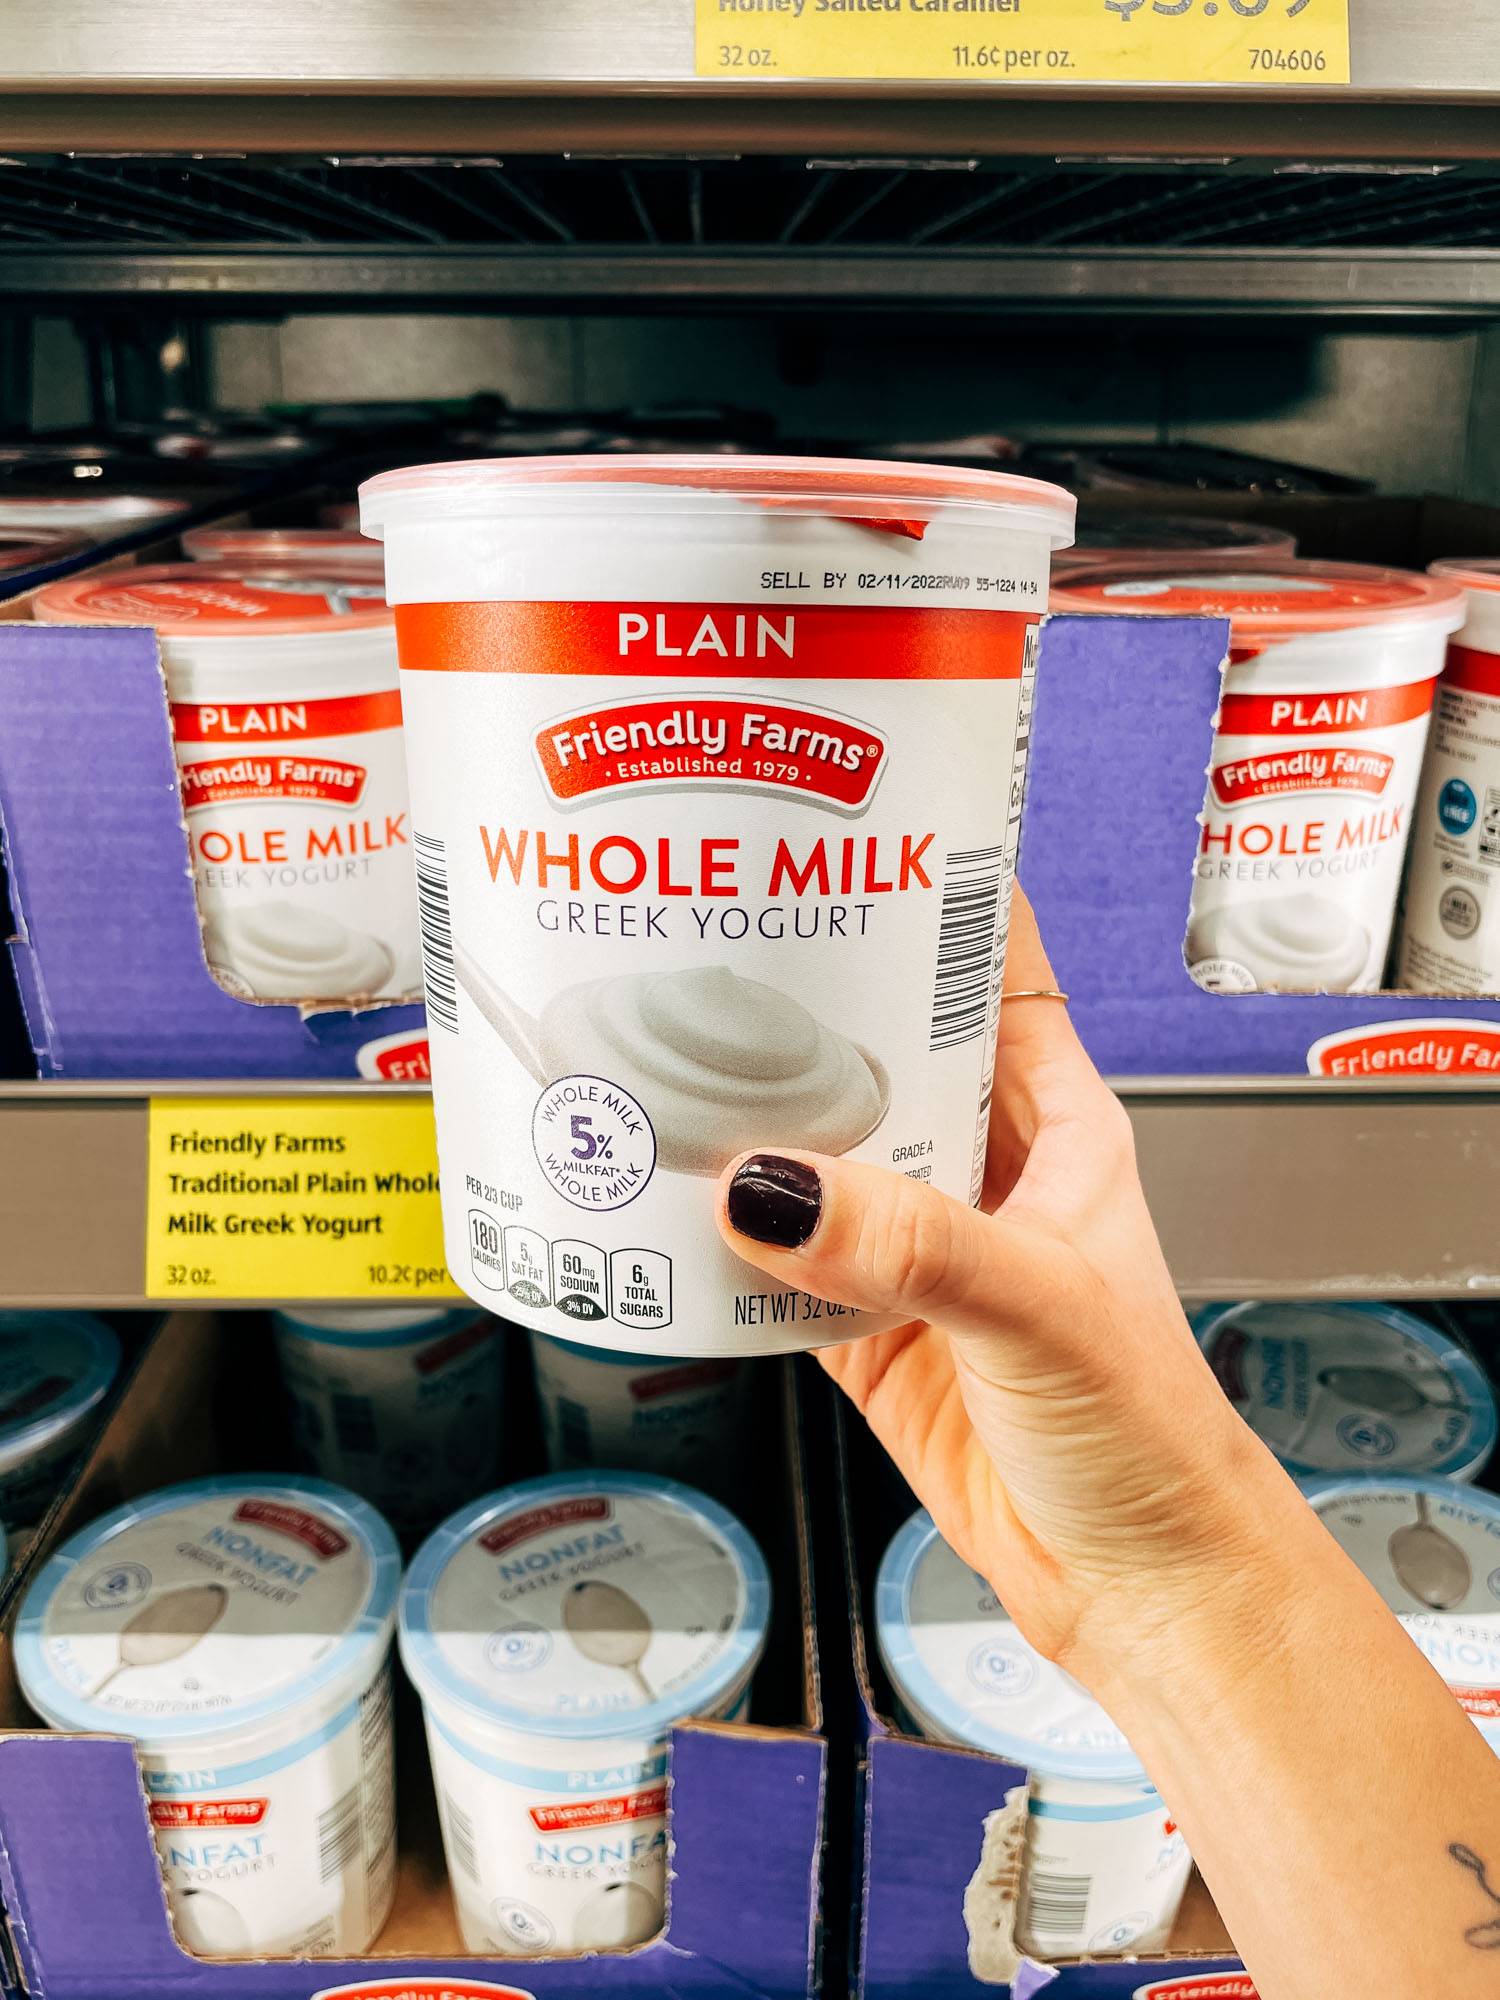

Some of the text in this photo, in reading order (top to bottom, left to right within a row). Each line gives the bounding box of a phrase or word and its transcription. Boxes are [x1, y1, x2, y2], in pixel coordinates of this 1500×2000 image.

[719, 46, 778, 66] 32 oz.
[953, 45, 1076, 71] 11.6¢ per oz.
[1248, 48, 1327, 70] 704606
[760, 571, 811, 590] SELL
[823, 571, 848, 590] BY
[618, 612, 795, 658] PLAIN
[199, 704, 307, 734] PLAIN
[1270, 696, 1369, 728] PLAIN
[550, 709, 727, 770] Friendly
[182, 759, 272, 788] riendly
[616, 756, 800, 781] Established 1979
[1221, 752, 1328, 789] Friendly
[198, 812, 409, 865] OLE MILK
[1200, 821, 1325, 856] HOLE
[1336, 802, 1404, 852] MILK
[203, 857, 373, 889] EEK YOGURT
[479, 824, 936, 897] WHOLE MILK
[1199, 859, 1284, 881] GREEK
[536, 899, 876, 940] GREEK YOGURT
[1331, 1040, 1455, 1077] Friendly
[542, 1086, 643, 1136] WHOLE MILK
[169, 1131, 347, 1159] Friendly Farms
[570, 1115, 613, 1160] 5%
[892, 1139, 934, 1162] GRADE A
[168, 1172, 300, 1195] Traditional
[306, 1172, 367, 1194] Plain
[545, 1153, 644, 1202] WHOLE MILK
[465, 1174, 524, 1213] PER 2/3 CUP
[168, 1212, 384, 1239] Milk Greek Yogurt
[472, 1218, 499, 1255] 180
[472, 1247, 502, 1272] CALORIES
[511, 1260, 544, 1282] SAT FAT
[562, 1253, 596, 1280] 60mg
[167, 1264, 216, 1285] 32 oz.
[414, 1266, 446, 1288] per
[560, 1274, 600, 1296] SODIUM
[632, 1264, 650, 1286] 6g
[566, 1300, 594, 1316] 3% DV
[624, 1285, 659, 1302] TOTAL
[619, 1303, 664, 1319] SUGARS
[735, 1294, 768, 1326] NET
[771, 1291, 799, 1323] WT
[803, 1292, 822, 1320] 32
[205, 1526, 321, 1585] NONFAT
[500, 1525, 625, 1581] NONFAT
[169, 1833, 268, 1868] NFAT
[535, 1829, 666, 1864] NONFA
